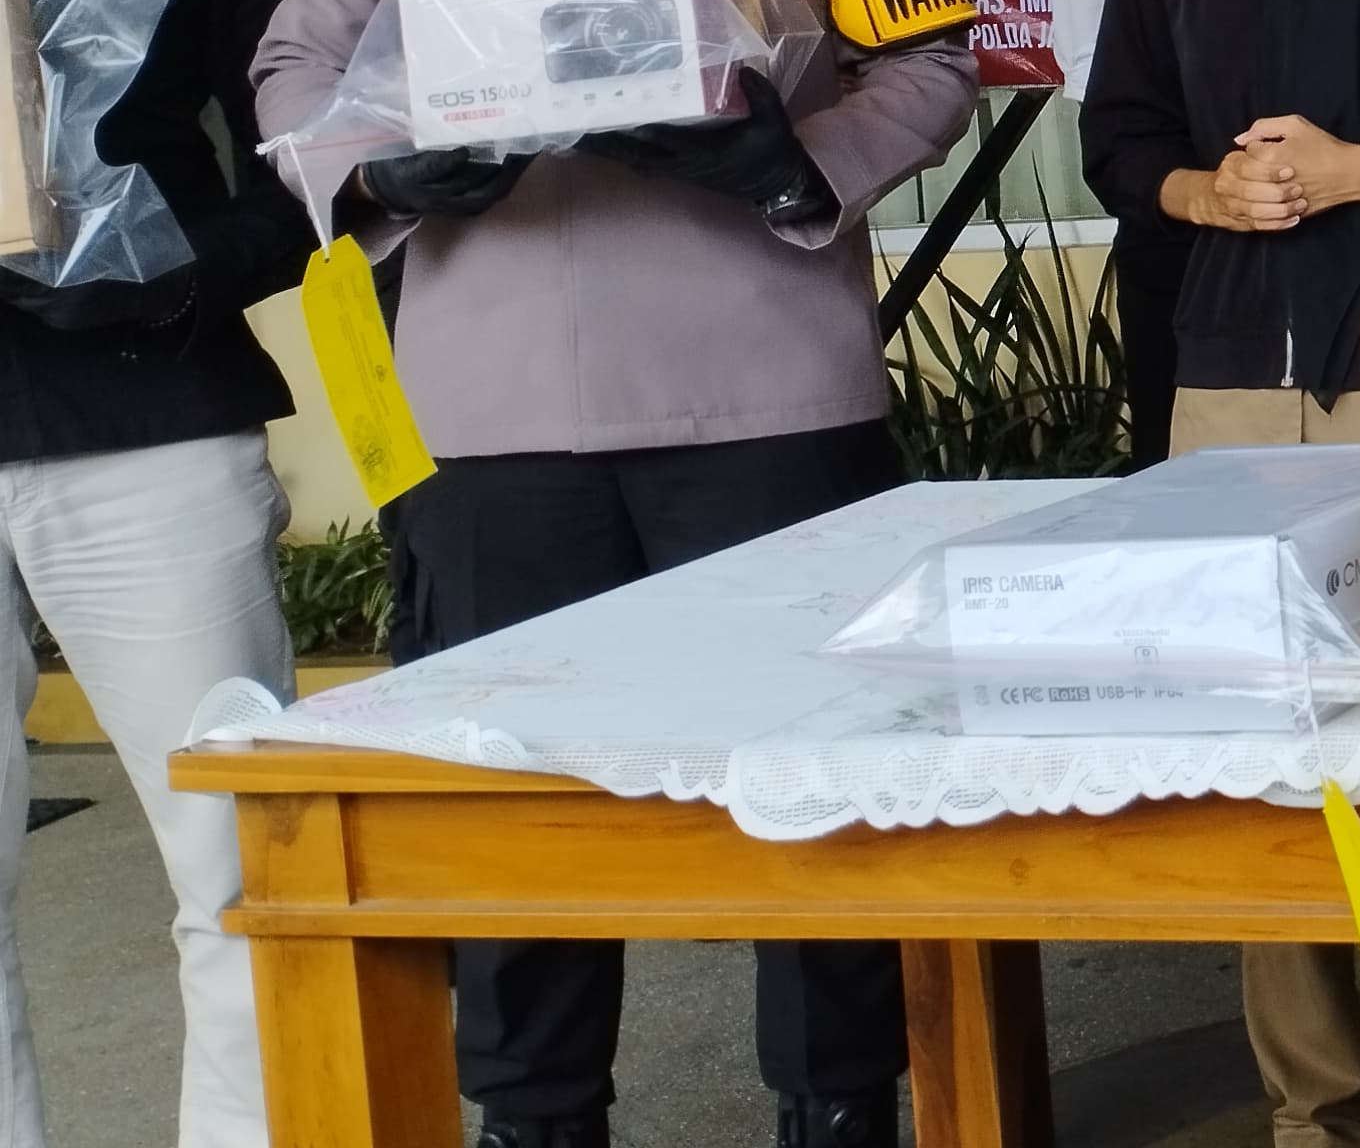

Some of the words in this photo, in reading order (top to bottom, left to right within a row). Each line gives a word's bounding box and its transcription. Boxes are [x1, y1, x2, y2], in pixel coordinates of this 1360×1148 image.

[968, 21, 1033, 51] POLDA
[427, 89, 475, 108] EOS
[480, 84, 533, 103] 1500D
[962, 576, 993, 594] IRIS
[999, 574, 1064, 593] CAMERA
[964, 597, 1009, 610] BMT-20
